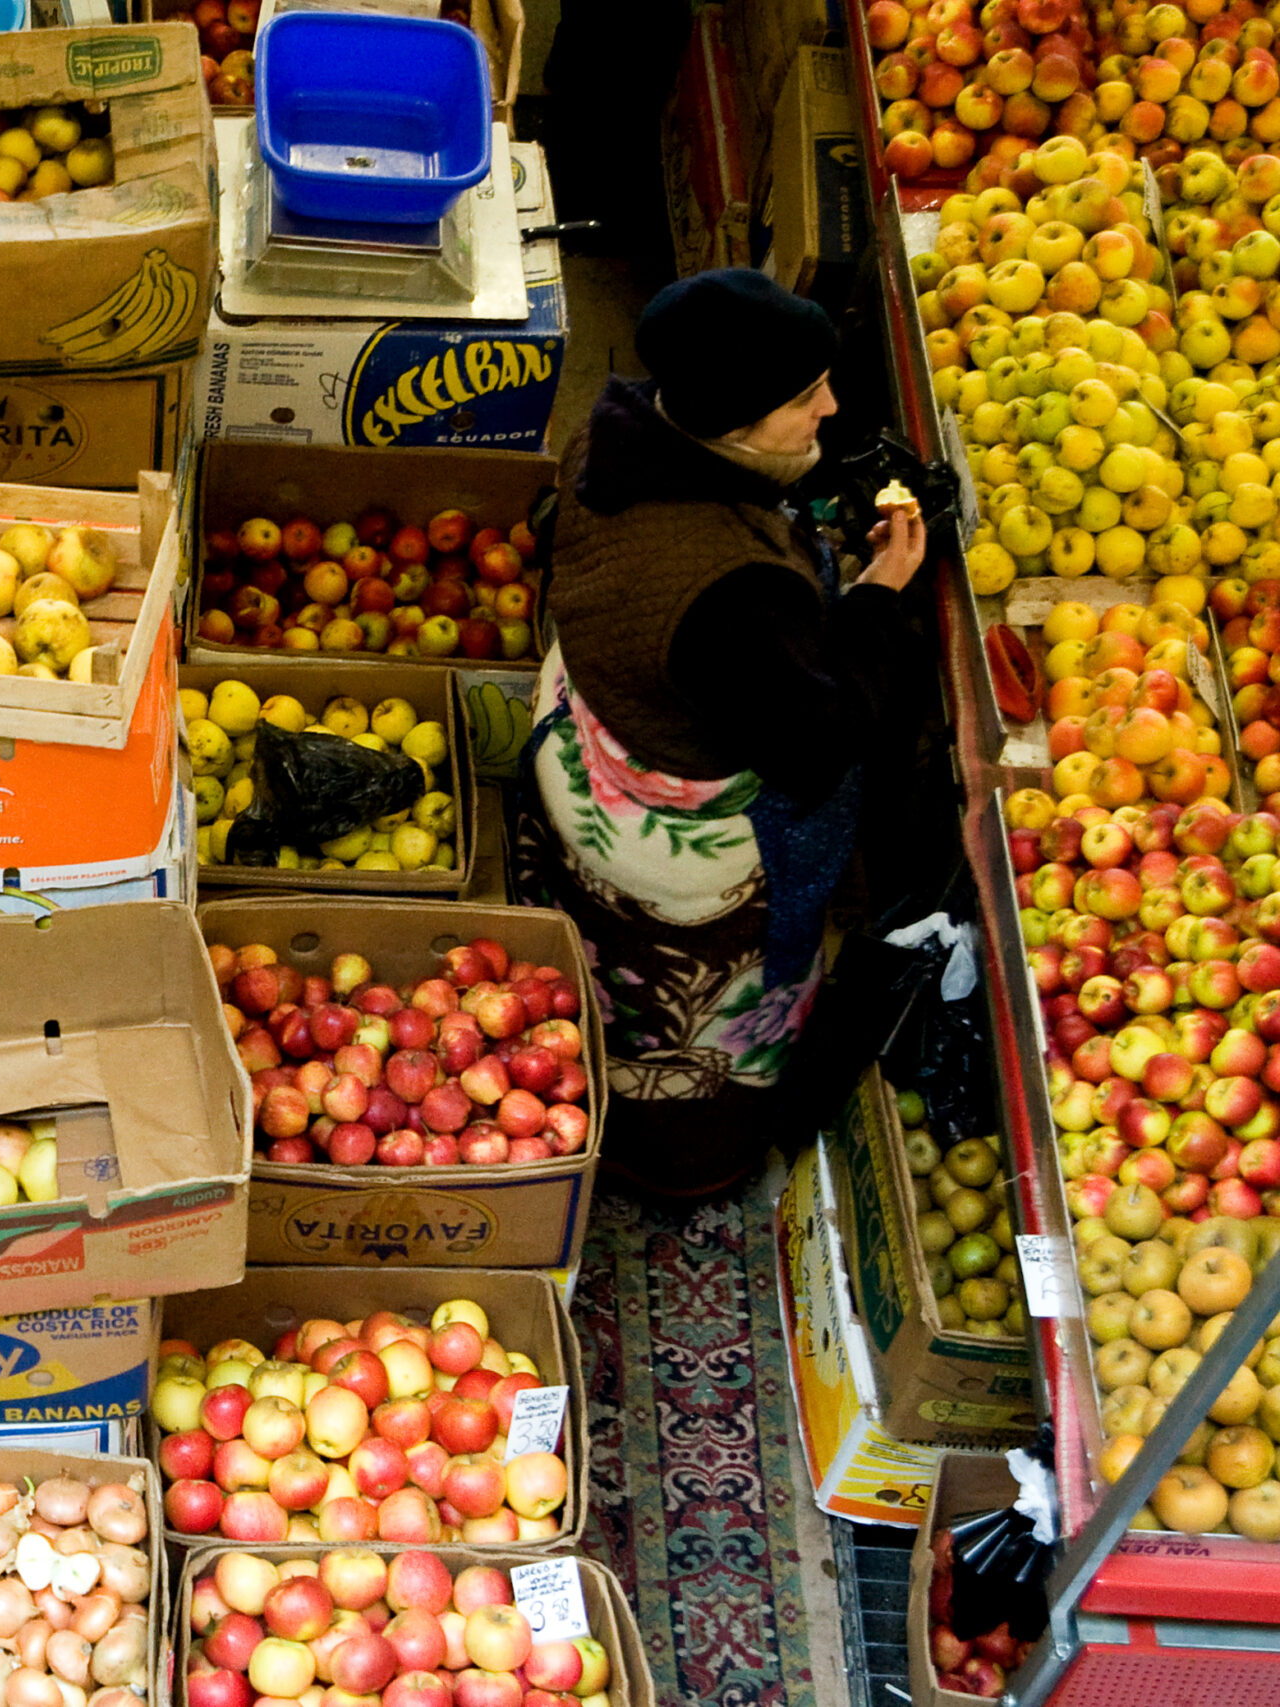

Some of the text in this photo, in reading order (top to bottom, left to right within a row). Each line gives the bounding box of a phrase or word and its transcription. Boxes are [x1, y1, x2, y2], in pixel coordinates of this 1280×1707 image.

[207, 343, 230, 404] BANANAS
[361, 340, 553, 448] EXCELBAN
[436, 429, 538, 444] ECUADOR
[172, 1187, 228, 1208] Quality
[128, 1211, 224, 1239] CAMEROON
[292, 1218, 488, 1241] FAVORITA
[4, 1305, 139, 1321] RODUCE OF
[16, 1317, 140, 1333] COSTA RICA
[50, 1329, 138, 1341] VACUUM PACK
[4, 1400, 142, 1422] BANANAS
[512, 1421, 533, 1455] 3
[1166, 1545, 1210, 1557] VAN
[529, 1600, 546, 1633] 3
